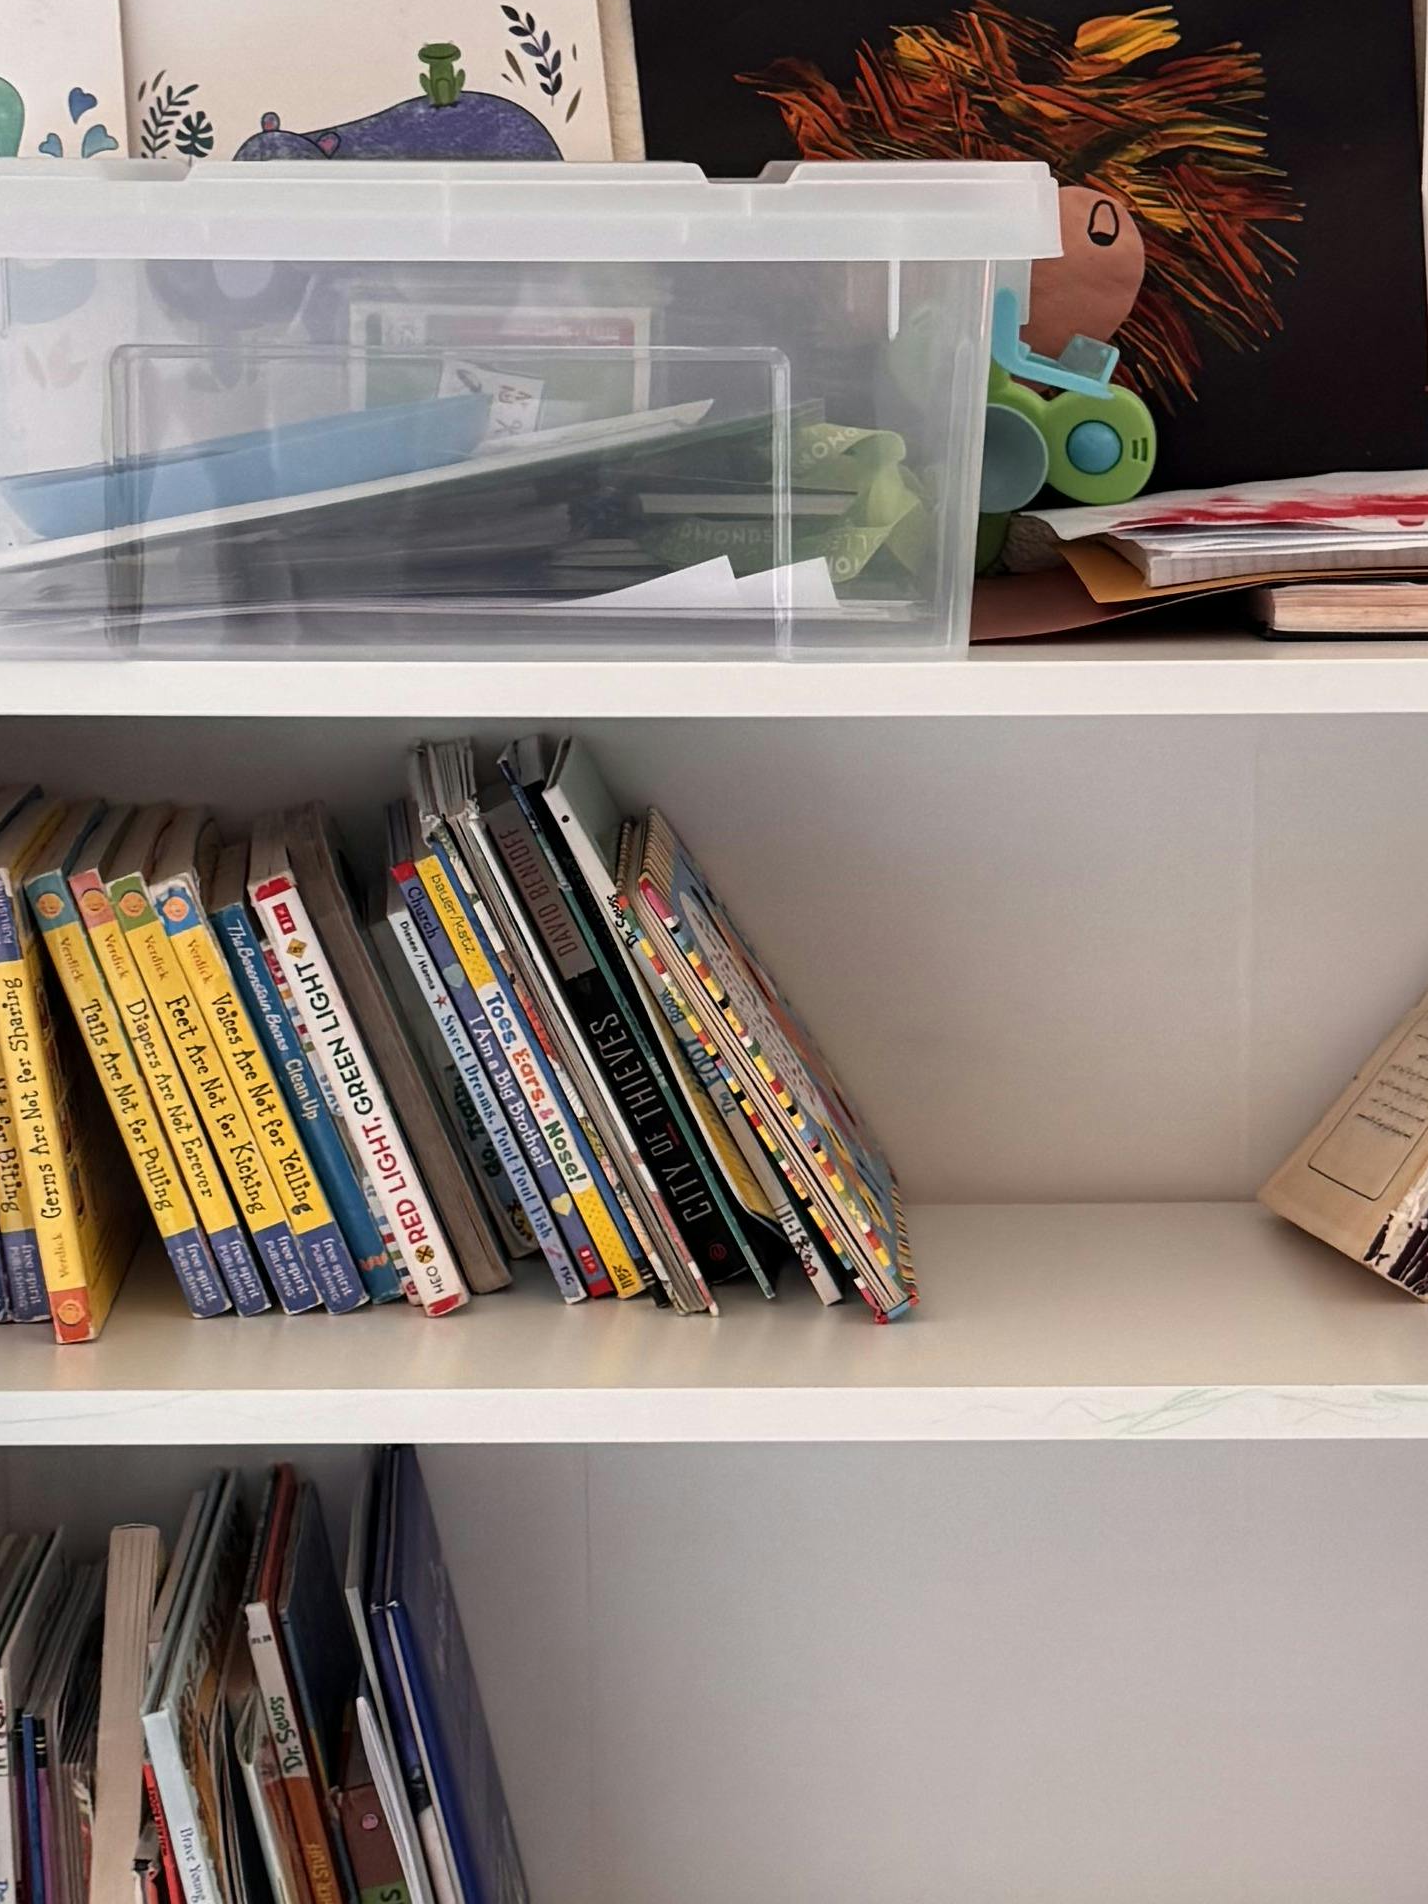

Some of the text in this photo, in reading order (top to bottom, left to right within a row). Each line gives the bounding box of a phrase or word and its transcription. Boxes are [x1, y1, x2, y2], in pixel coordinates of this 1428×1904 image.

[282, 1058, 318, 1121] Clean Up
[293, 960, 341, 1037] LIGHT
[327, 1036, 374, 1115] GREEN
[406, 886, 551, 1170] Church Am Big Brother!
[483, 992, 588, 1184] Toes, Ears, Nose!
[498, 822, 714, 1224] CITY OF THIEVES DAVID BENIOFF
[3, 977, 64, 1221] Germs Sharing
[80, 999, 174, 1213] Tails Pulling
[126, 998, 214, 1200] Diapers Forever
[166, 993, 266, 1216] Feet Kicking
[209, 991, 314, 1217] Voices Yelling
[361, 1116, 406, 1196] LIGHT,
[441, 1014, 551, 1239] Sweet Dreams, Pout-Pout Fish
[396, 1198, 429, 1246] RED
[270, 1696, 303, 1773] Dr. Seuss
[180, 1826, 196, 1862] Brave
[189, 1863, 206, 1904] Young
